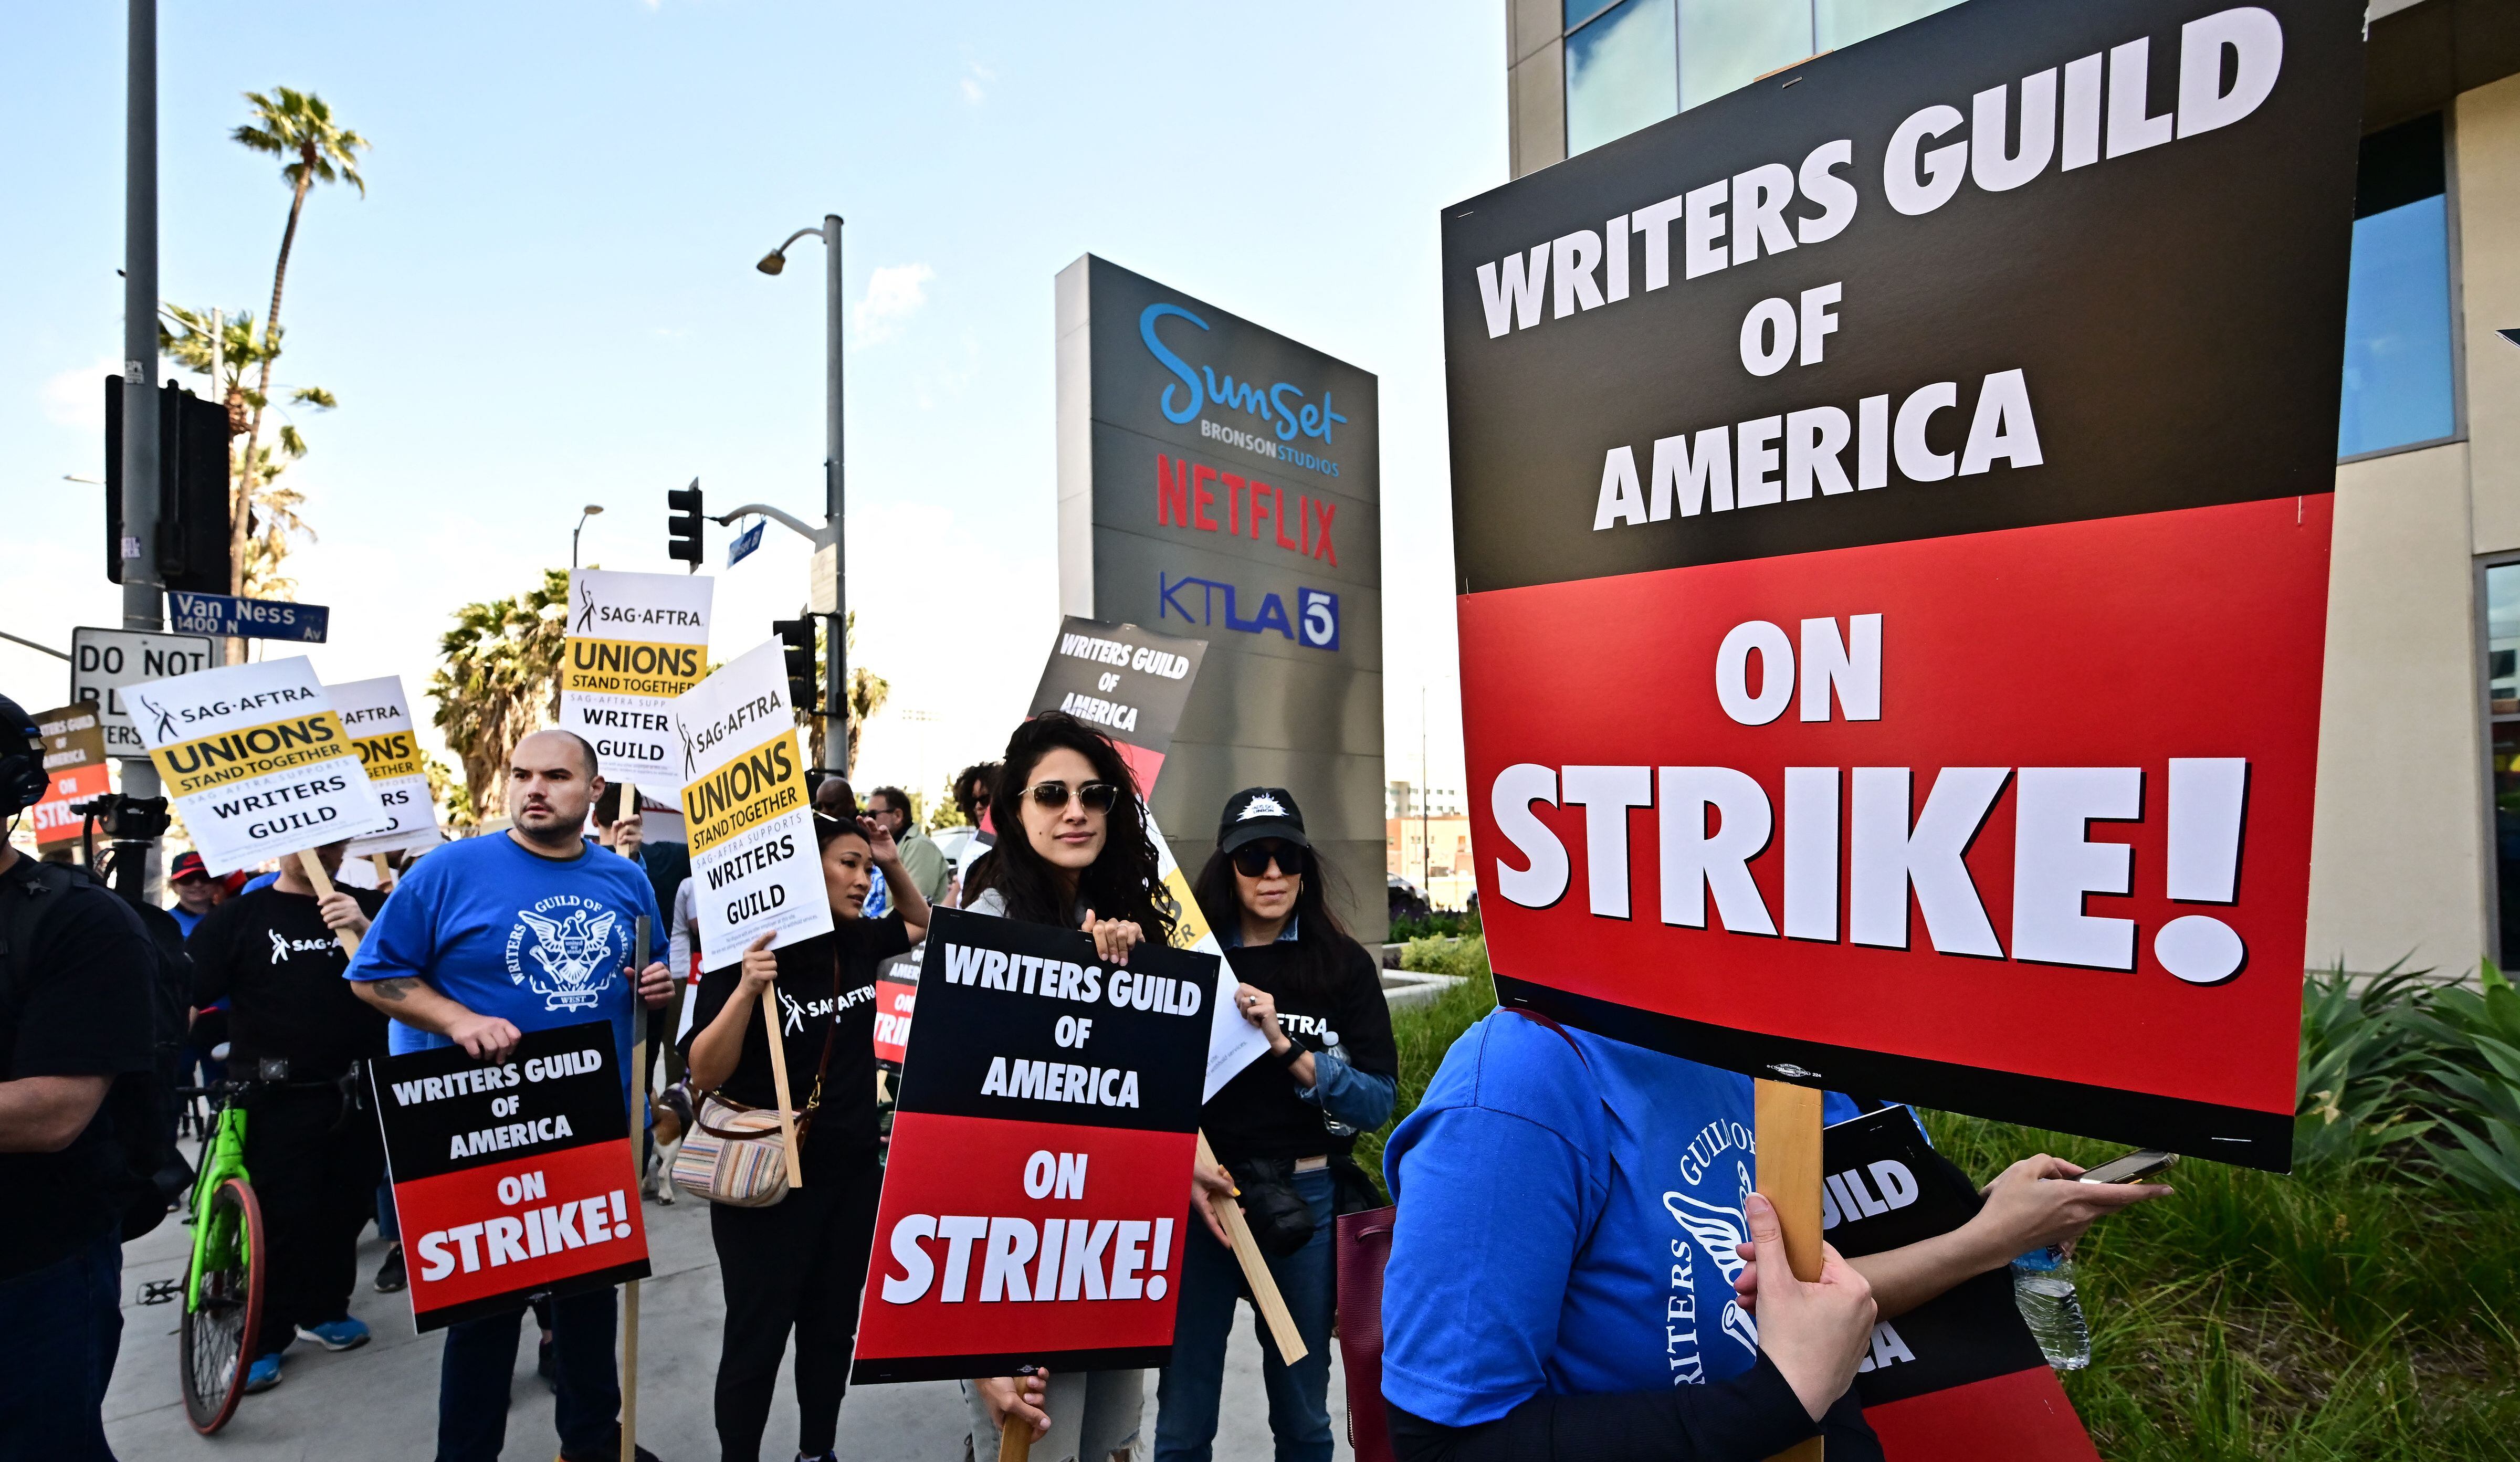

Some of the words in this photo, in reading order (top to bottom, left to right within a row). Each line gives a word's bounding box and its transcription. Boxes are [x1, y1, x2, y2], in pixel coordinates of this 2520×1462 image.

[1476, 139, 1858, 340] WRITERS
[1883, 6, 2284, 216] GUILD
[1739, 281, 1842, 377] OF
[1593, 367, 2044, 531] AMERICA
[1158, 453, 1338, 567] NETFLIX
[177, 594, 223, 619] Van
[235, 599, 296, 625] Ness
[177, 617, 218, 631] 1400
[226, 620, 238, 634] N
[1160, 571, 1294, 640] KTLA
[1305, 592, 1335, 646] 5
[303, 626, 322, 640] Av
[80, 645, 123, 674] DO
[144, 650, 205, 677] NOT
[574, 641, 697, 677] UNIONS
[1060, 633, 1133, 667] WRITERS
[1132, 647, 1189, 679] GUILD
[1715, 613, 1883, 726] ON
[572, 675, 620, 690] STAND
[1098, 672, 1120, 692] OF
[583, 708, 669, 732] WRITER
[639, 699, 667, 708] SUPP
[1059, 692, 1138, 732] AMERICA
[165, 717, 334, 773] UNIONS
[596, 740, 664, 762] GUILD
[59, 777, 77, 794] ON
[181, 766, 244, 792] STAND
[246, 744, 342, 773] TOGETHER
[279, 759, 351, 782] SUPPORTS
[688, 741, 792, 825] UNIONS
[213, 775, 346, 819] WRITERS
[694, 819, 729, 849] STAND
[731, 786, 797, 830] TOGETHER
[248, 806, 337, 839] GUILD
[748, 813, 802, 845] SUPPORTS
[707, 834, 795, 891] WRITERS
[1490, 756, 2249, 986] STRIKE!
[727, 884, 785, 925] GUILD
[506, 923, 526, 985] WRITERS
[535, 895, 580, 912] GUILD
[583, 898, 603, 912] OF
[889, 962, 920, 981] AMER
[945, 943, 1101, 1003] WRITERS
[1108, 970, 1202, 1017] GUILD
[560, 995, 586, 1004] WEST
[895, 993, 915, 1013] ON
[1054, 1015, 1093, 1049] OF
[391, 1063, 520, 1107] WRITERS
[524, 1048, 602, 1084] GUILD
[981, 1056, 1139, 1109] AMERICA
[491, 1095, 520, 1119] OF
[449, 1114, 573, 1160] AMERICA
[497, 1170, 547, 1206] ON
[1023, 1150, 1088, 1200] ON
[417, 1190, 633, 1282] STRIKE!
[881, 1214, 1174, 1304] STRIKE!
